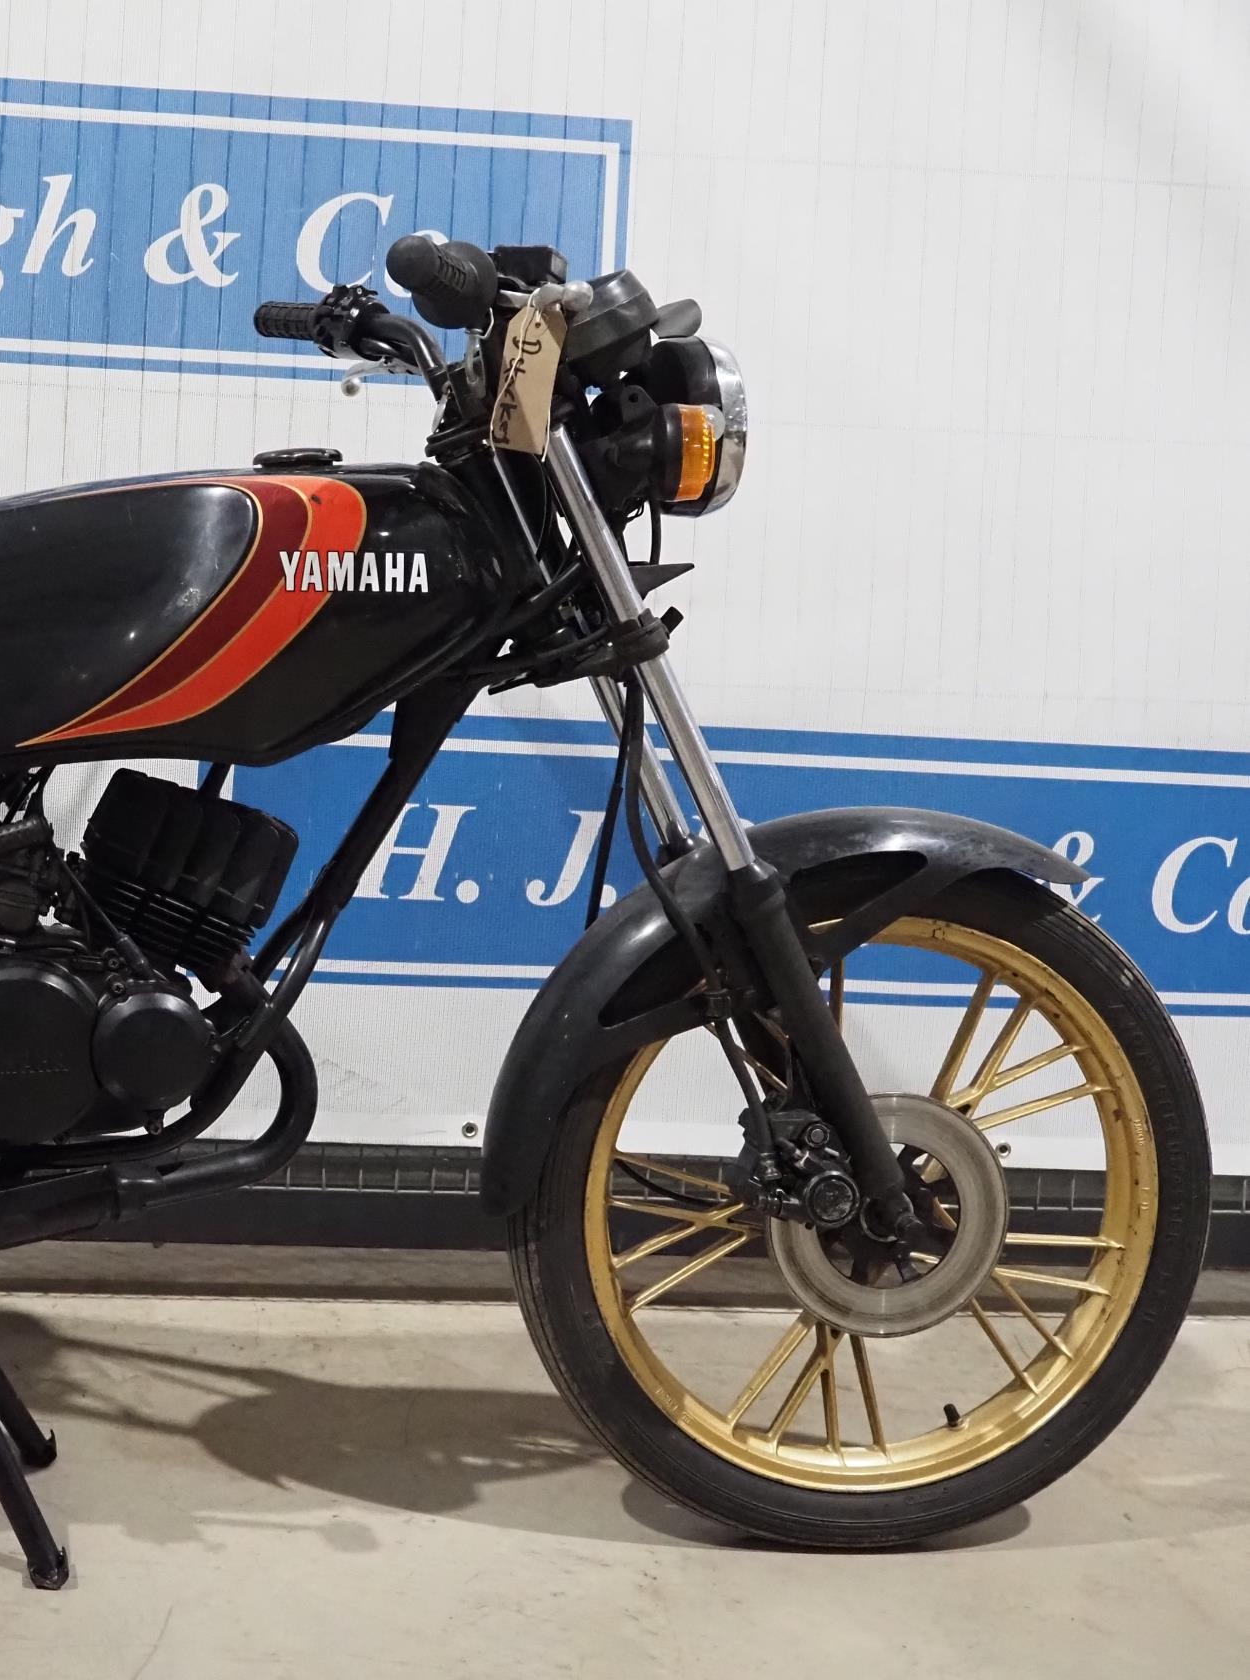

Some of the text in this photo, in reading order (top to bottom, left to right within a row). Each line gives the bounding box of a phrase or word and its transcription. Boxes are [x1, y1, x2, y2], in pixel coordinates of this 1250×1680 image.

[144, 183, 240, 287] &
[279, 551, 429, 592] YAMAHA
[353, 803, 617, 907] H. J.
